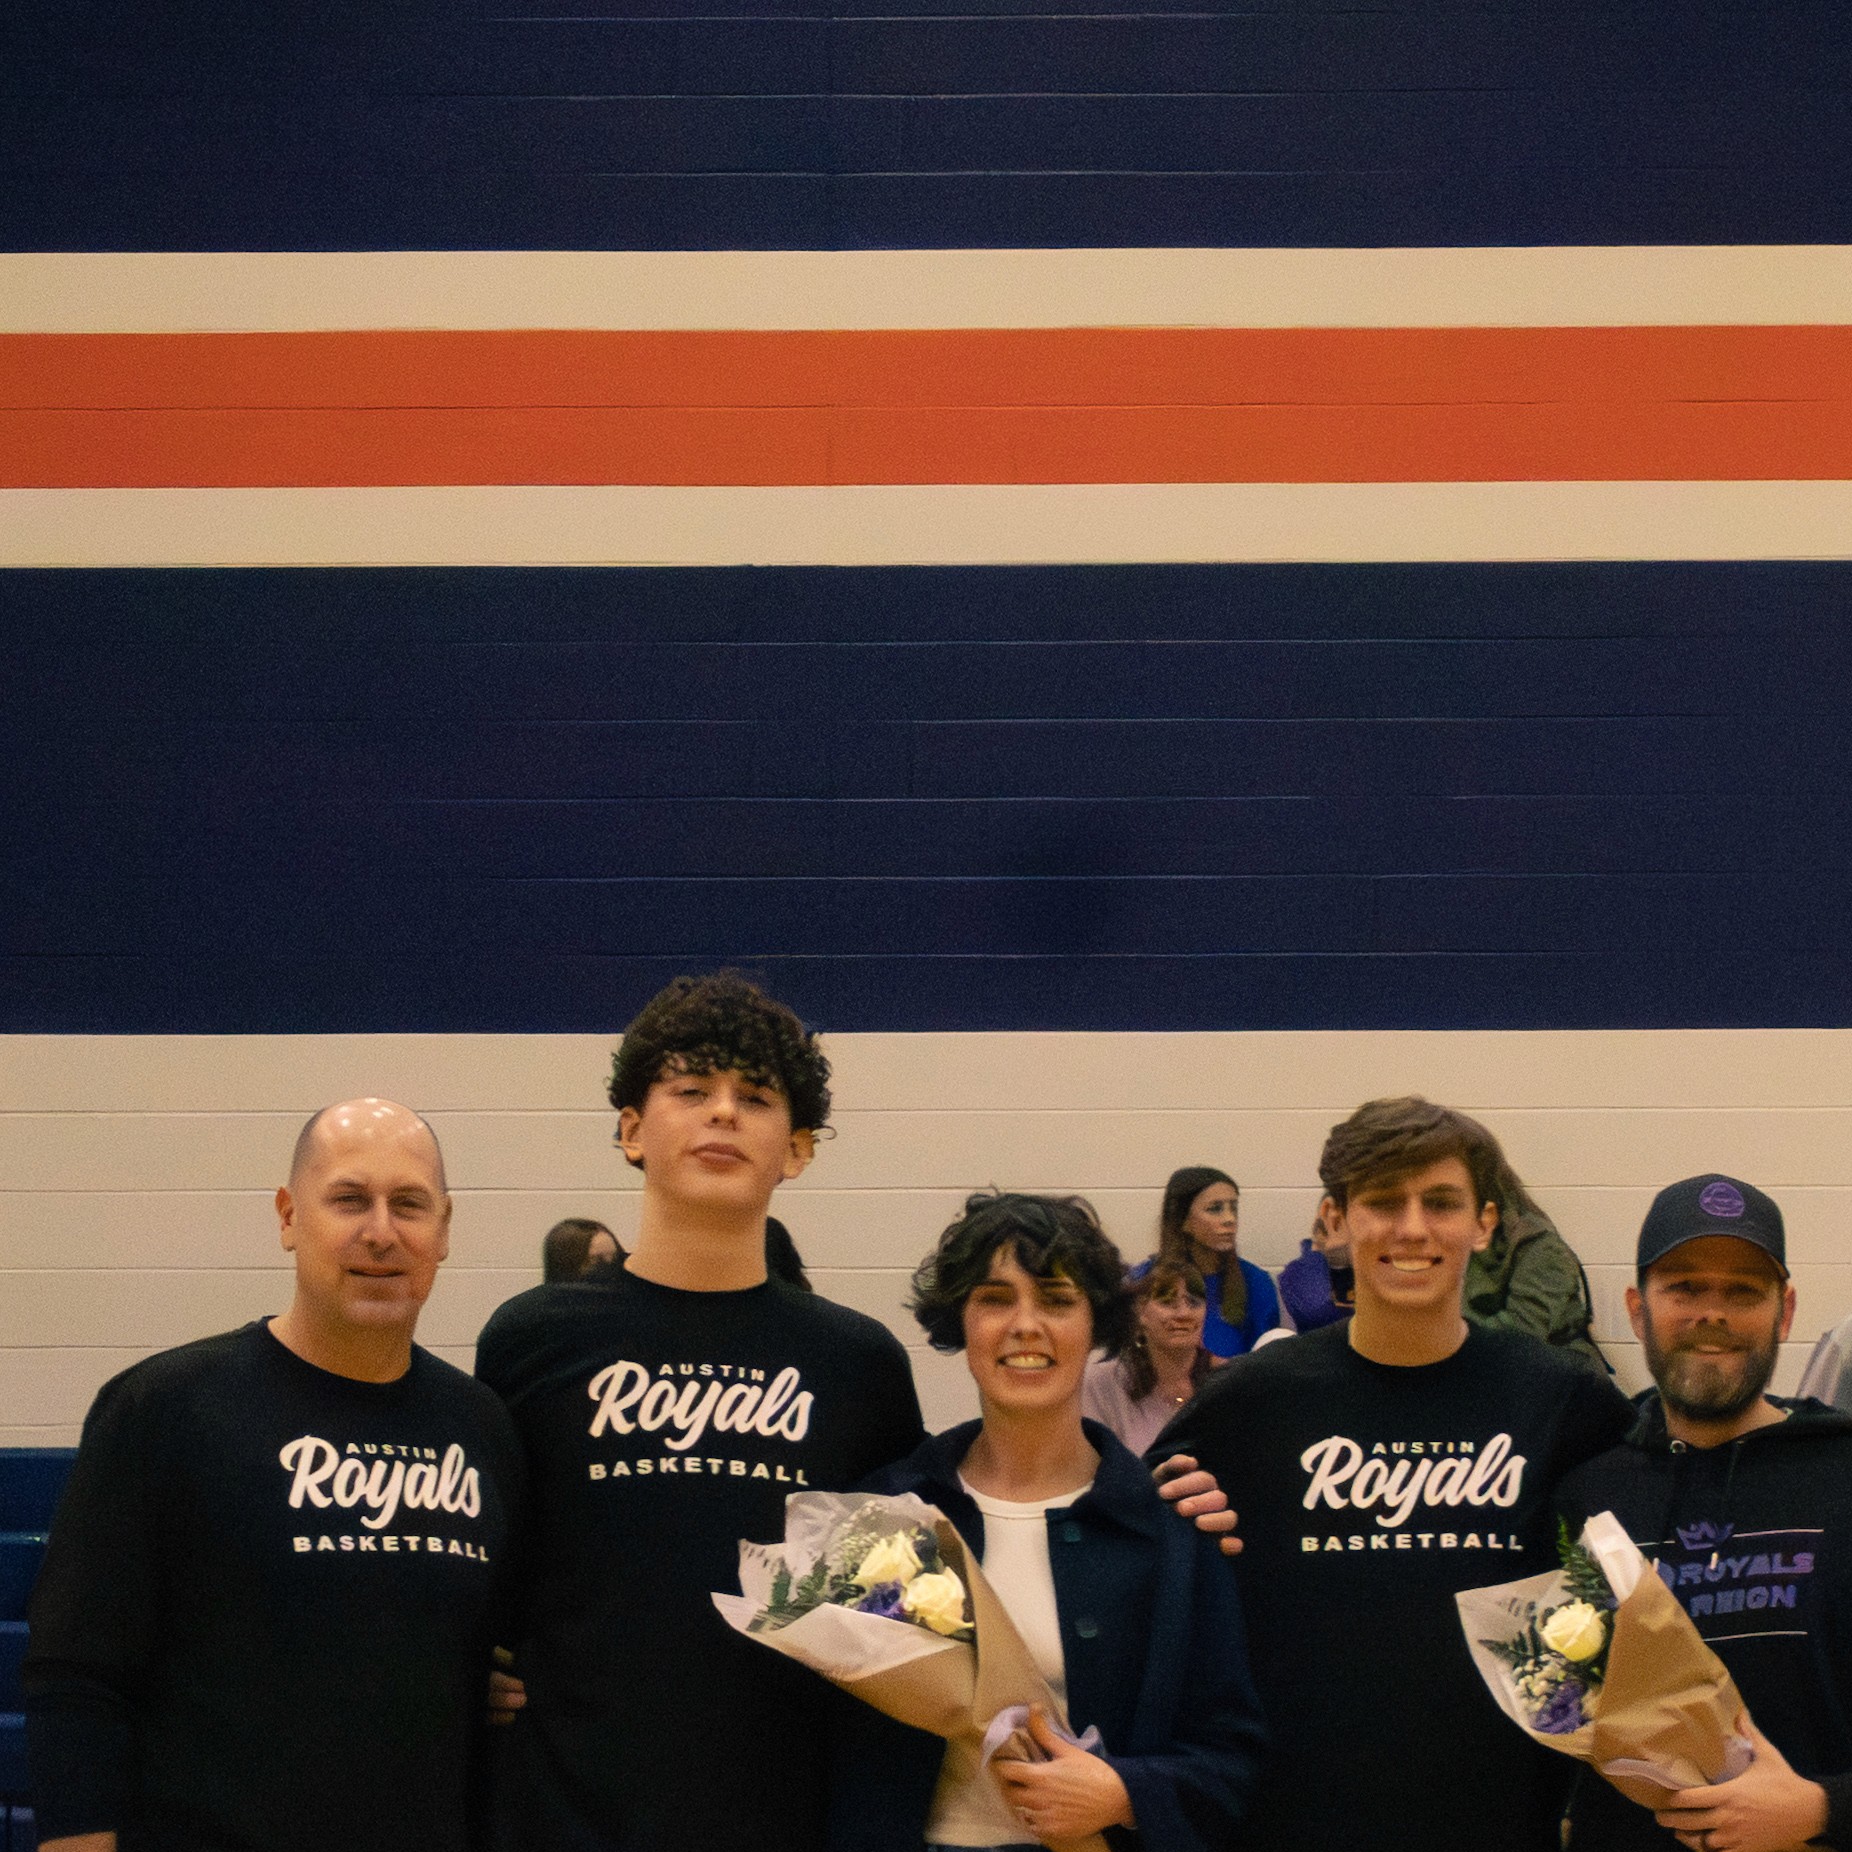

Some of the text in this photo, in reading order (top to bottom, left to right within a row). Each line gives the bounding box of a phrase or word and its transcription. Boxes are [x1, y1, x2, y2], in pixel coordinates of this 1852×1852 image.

[658, 1363, 766, 1382] AUSTIN
[587, 1359, 815, 1451] Royals
[345, 1442, 438, 1461] AUSTIN
[1371, 1441, 1475, 1455] AUSTIN
[278, 1434, 481, 1530] Royals
[588, 1456, 810, 1487] BASKETBALL
[1300, 1432, 1528, 1528] Royals
[292, 1534, 490, 1562] BASKETBALL
[1301, 1533, 1525, 1553] BASKETBALL
